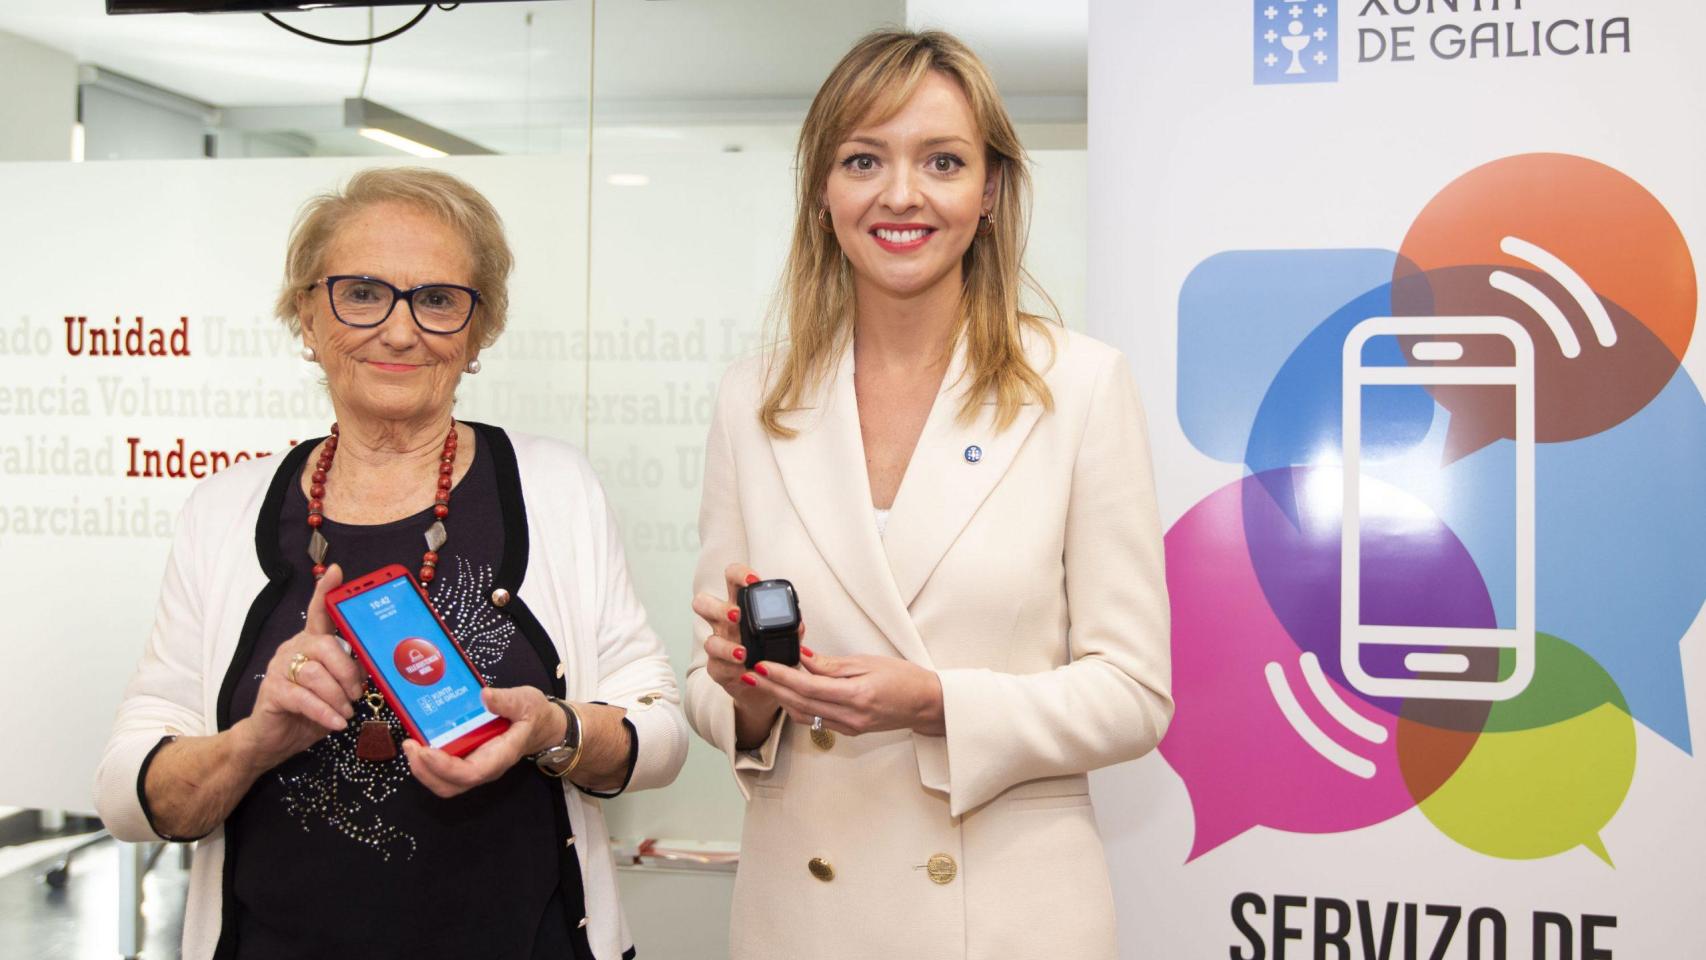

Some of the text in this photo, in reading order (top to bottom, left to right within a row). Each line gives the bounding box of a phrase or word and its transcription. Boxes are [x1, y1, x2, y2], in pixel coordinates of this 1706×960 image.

[1358, 17, 1631, 63] DE GALICIA
[64, 316, 190, 356] Unidad
[489, 318, 708, 361] umanidad
[0, 433, 115, 476] alidad
